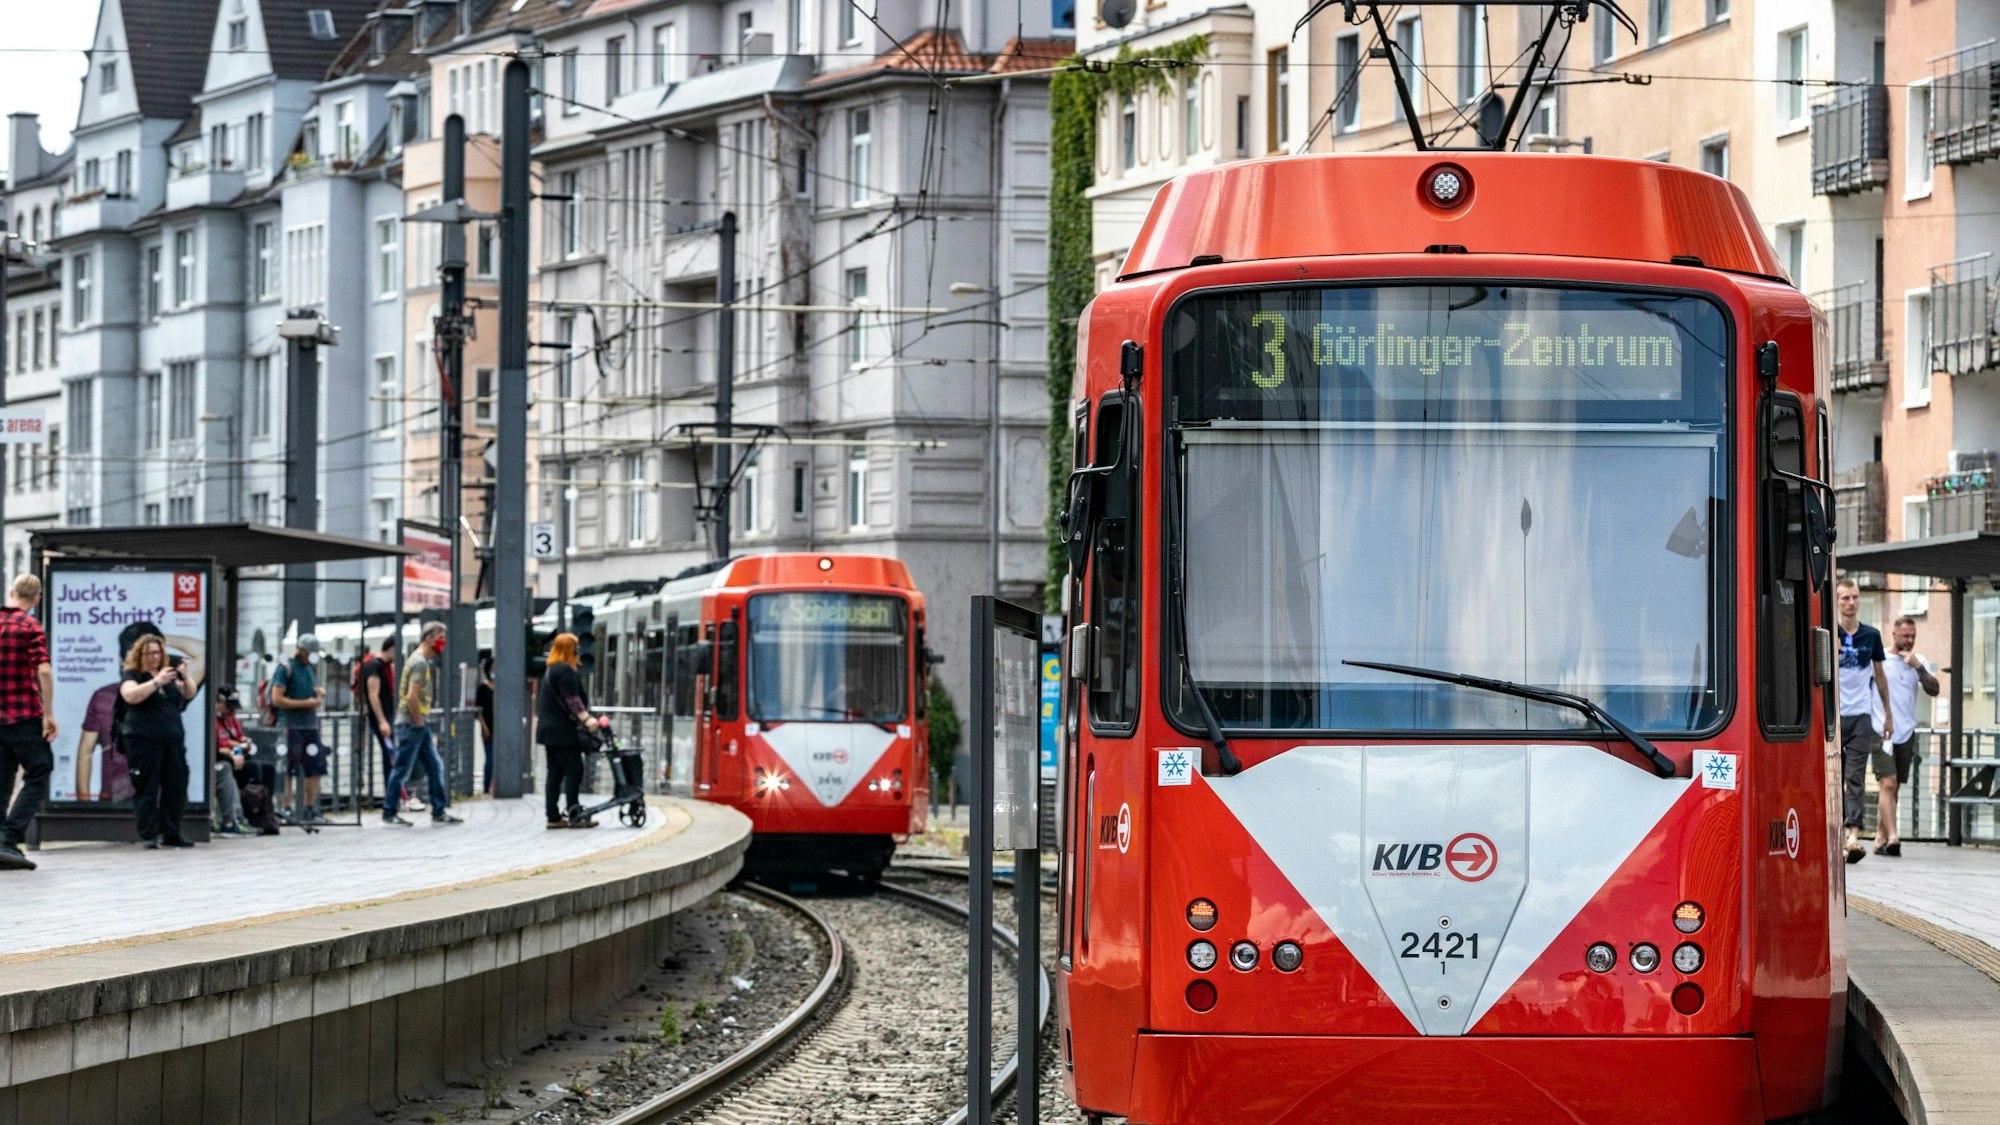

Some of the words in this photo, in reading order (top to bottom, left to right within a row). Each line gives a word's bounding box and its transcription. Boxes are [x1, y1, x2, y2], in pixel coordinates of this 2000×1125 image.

[1251, 311, 1285, 388] 3
[1312, 323, 1673, 375] Görlinger-Zentrum
[7, 418, 42, 433] arena
[536, 532, 552, 554] 3
[57, 583, 128, 602] Juckt's
[57, 607, 81, 624] im
[88, 607, 166, 625] Schritt?
[791, 602, 889, 624] Schlebusch
[1100, 815, 1118, 843] KVB
[1769, 821, 1786, 848] KVB
[1372, 843, 1443, 871] KVB
[1400, 932, 1479, 959] 2421
[1440, 961, 1446, 975] 1
